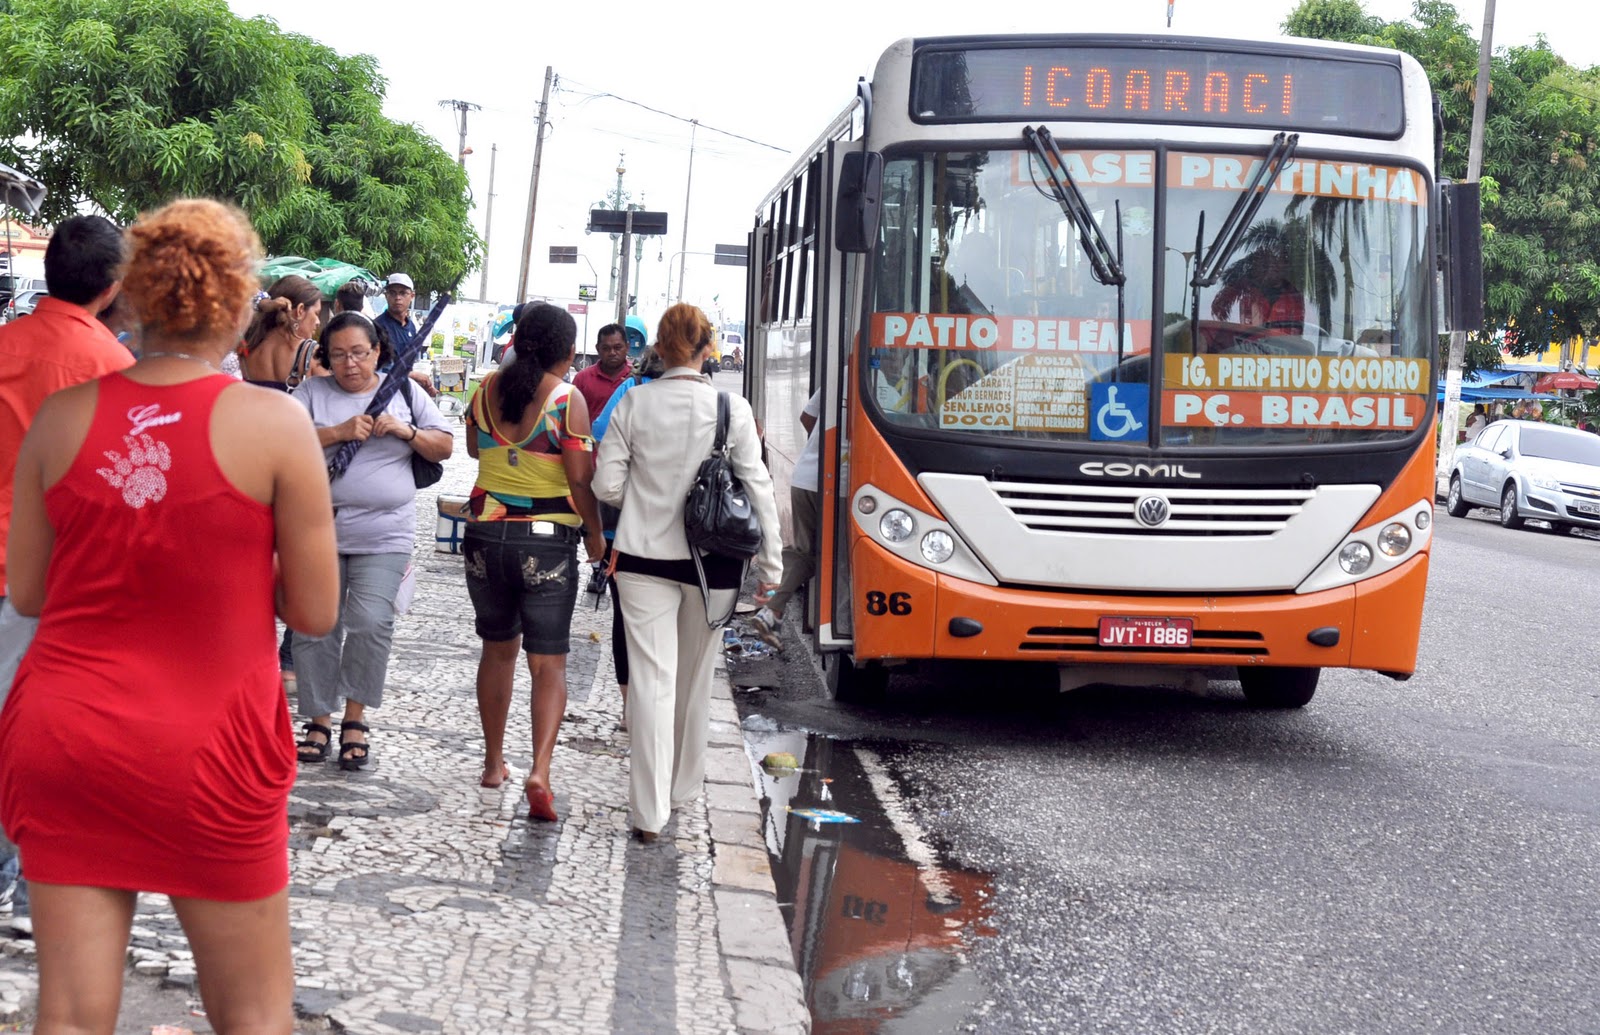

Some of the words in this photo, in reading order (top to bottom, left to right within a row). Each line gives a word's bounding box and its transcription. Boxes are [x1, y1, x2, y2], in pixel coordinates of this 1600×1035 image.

[1023, 66, 1291, 115] ICOARACI
[1018, 153, 1153, 184] BASE
[1181, 155, 1418, 203] PRATINHA
[884, 314, 999, 348] PÁTIO
[1012, 319, 1134, 353] BELÉM
[1035, 356, 1073, 367] VOLTA
[1182, 356, 1211, 387] IG.
[1218, 357, 1323, 389] PERPETUO
[1328, 359, 1420, 391] SOCORRO
[943, 414, 1011, 426] DOCA
[1174, 394, 1244, 426] PÇ.
[1261, 396, 1414, 427] BRASIL
[866, 590, 912, 616] 86
